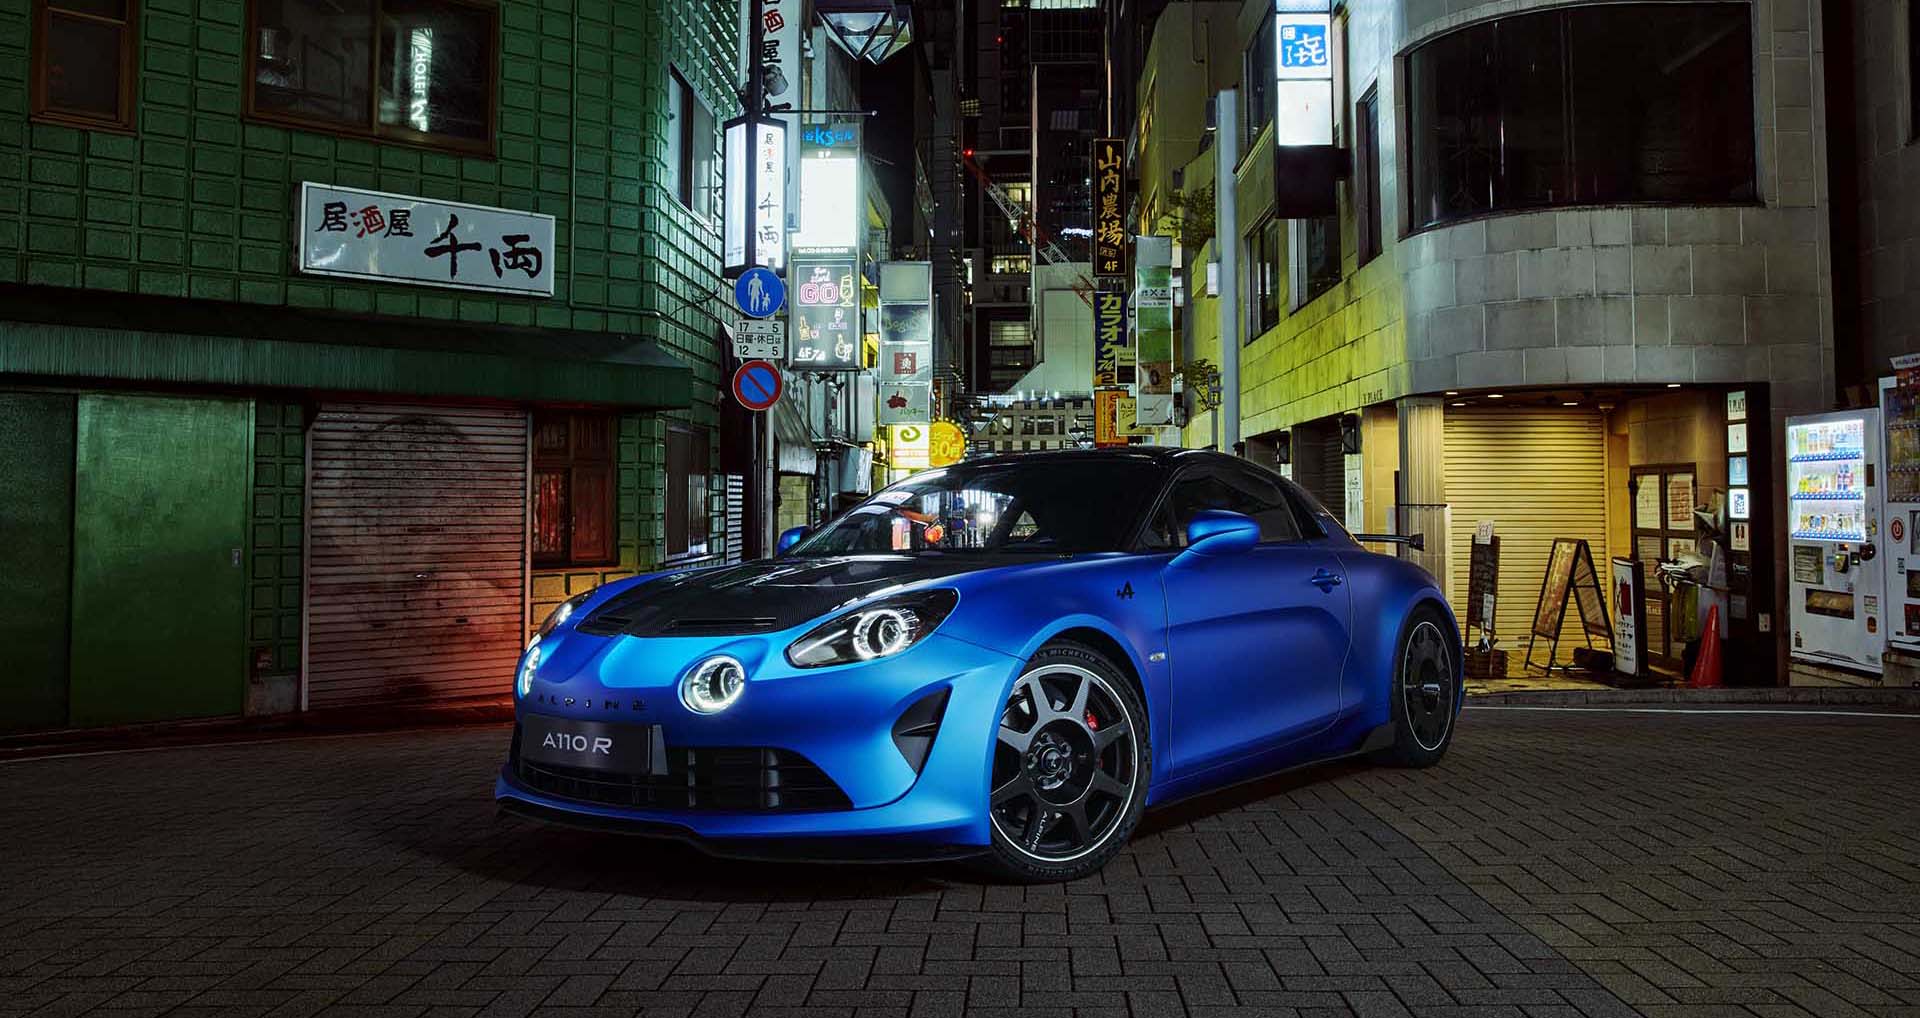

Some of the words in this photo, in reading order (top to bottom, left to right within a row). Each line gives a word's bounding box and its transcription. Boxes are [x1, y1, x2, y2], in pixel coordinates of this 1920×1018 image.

[1098, 145, 1123, 246] 山内農場
[315, 201, 413, 238] 居酒屋
[424, 213, 542, 279] 千両
[1104, 260, 1118, 271] 4F
[800, 282, 839, 304] GO
[739, 322, 749, 332] 17
[772, 323, 779, 332] 5
[1100, 293, 1122, 360] カラオケ
[739, 345, 749, 355] 12
[772, 346, 779, 356] 5
[1049, 647, 1097, 662] MICHELIN
[537, 694, 648, 711] ALPINE
[543, 732, 588, 752] A110
[592, 737, 613, 754] R
[1030, 811, 1048, 851] ALPINE
